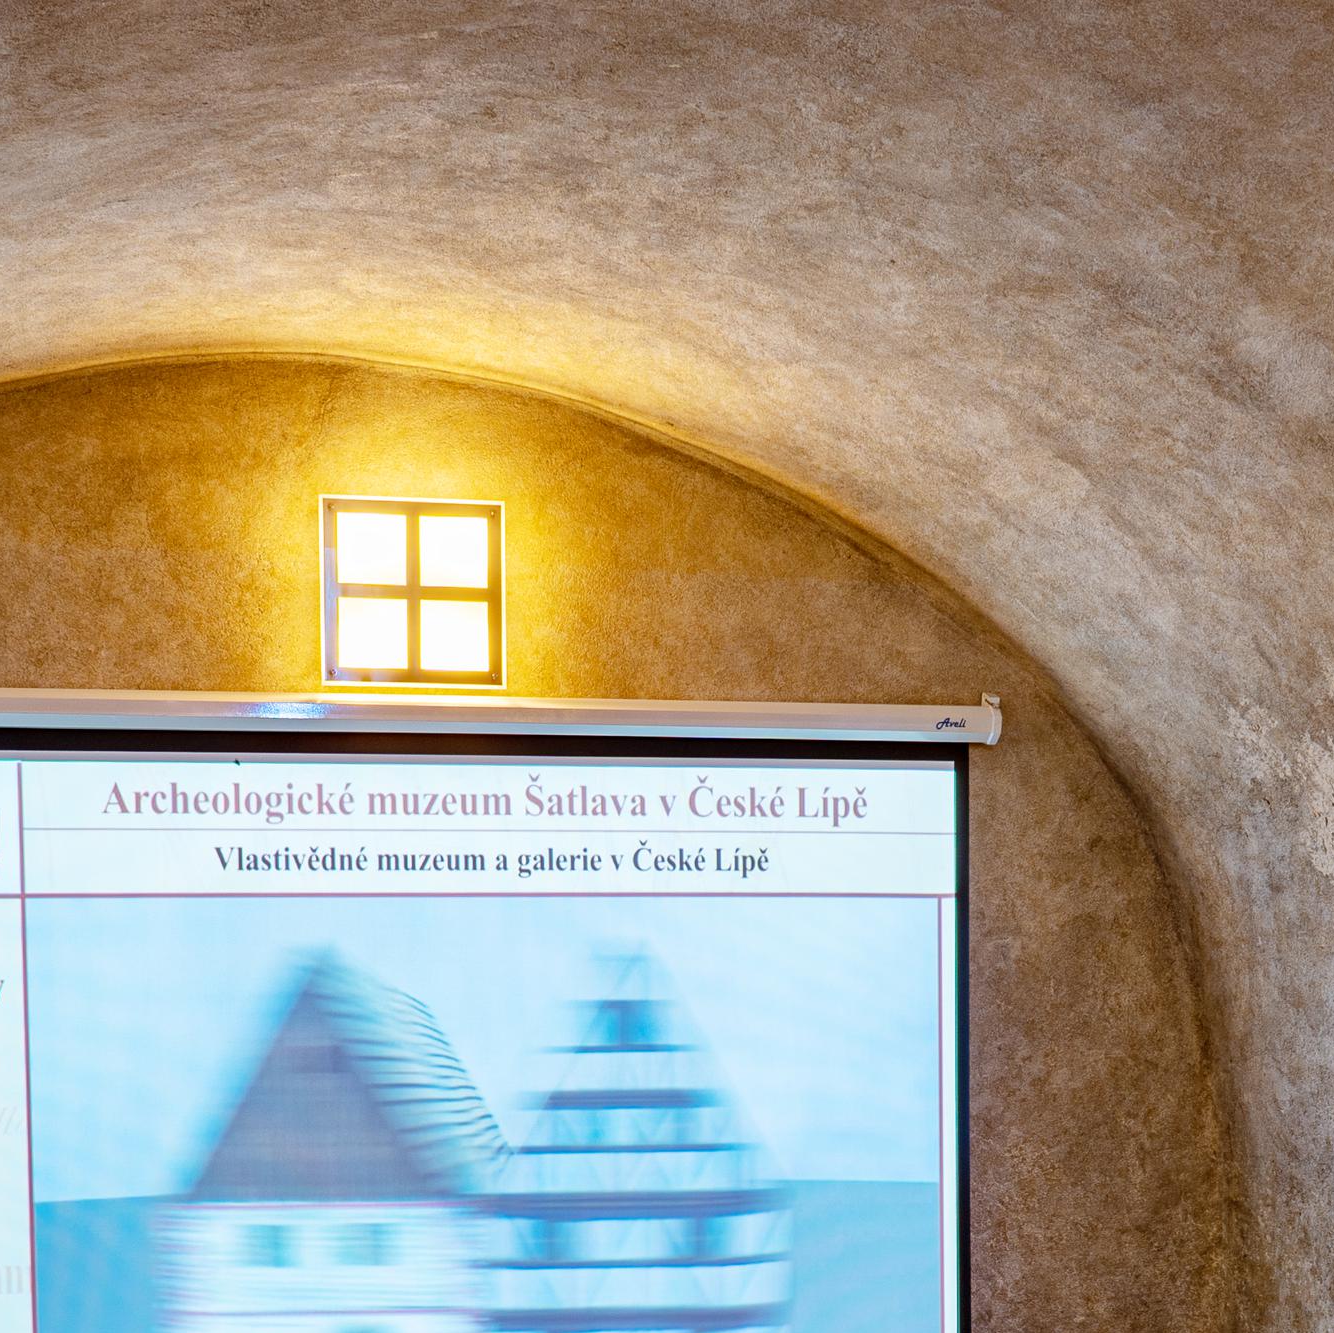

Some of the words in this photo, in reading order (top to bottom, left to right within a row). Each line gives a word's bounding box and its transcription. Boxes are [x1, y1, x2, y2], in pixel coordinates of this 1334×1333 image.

[102, 782, 355, 824] Archeologické
[367, 791, 513, 817] muzeum
[525, 773, 648, 818] Šatlava
[659, 794, 677, 818] v
[688, 775, 785, 819] České
[796, 785, 868, 828] Lípě
[214, 846, 368, 872] Vlastivědné
[377, 853, 486, 872] muzeum
[495, 854, 509, 872] a
[517, 847, 602, 878] galerie
[611, 854, 624, 872] v
[633, 840, 705, 873] České
[715, 847, 769, 878] Lípě
